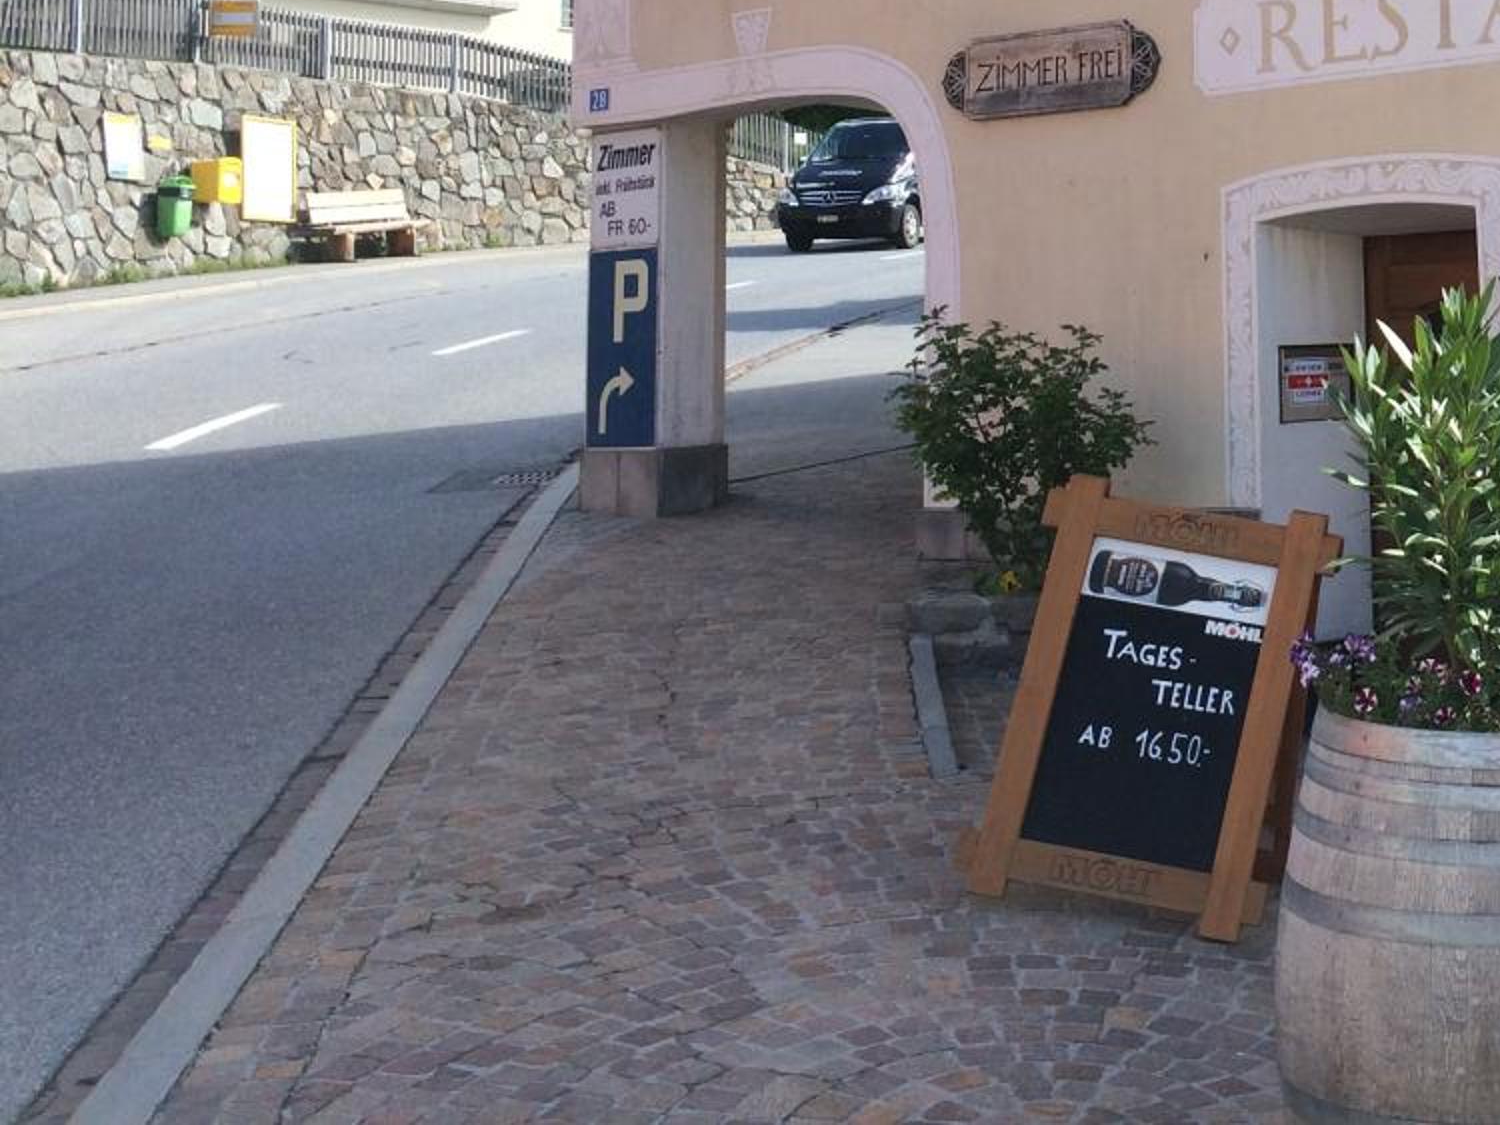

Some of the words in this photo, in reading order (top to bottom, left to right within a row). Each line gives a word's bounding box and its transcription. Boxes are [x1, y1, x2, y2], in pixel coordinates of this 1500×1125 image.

[974, 55, 1069, 93] ZIMMER
[1077, 42, 1123, 82] FREI
[591, 90, 608, 109] 28
[597, 142, 657, 172] Zimmer
[599, 200, 617, 218] AB
[607, 220, 625, 237] FR
[612, 257, 649, 343] P
[1151, 679, 1235, 716] TELLER
[1077, 723, 1113, 749] AB
